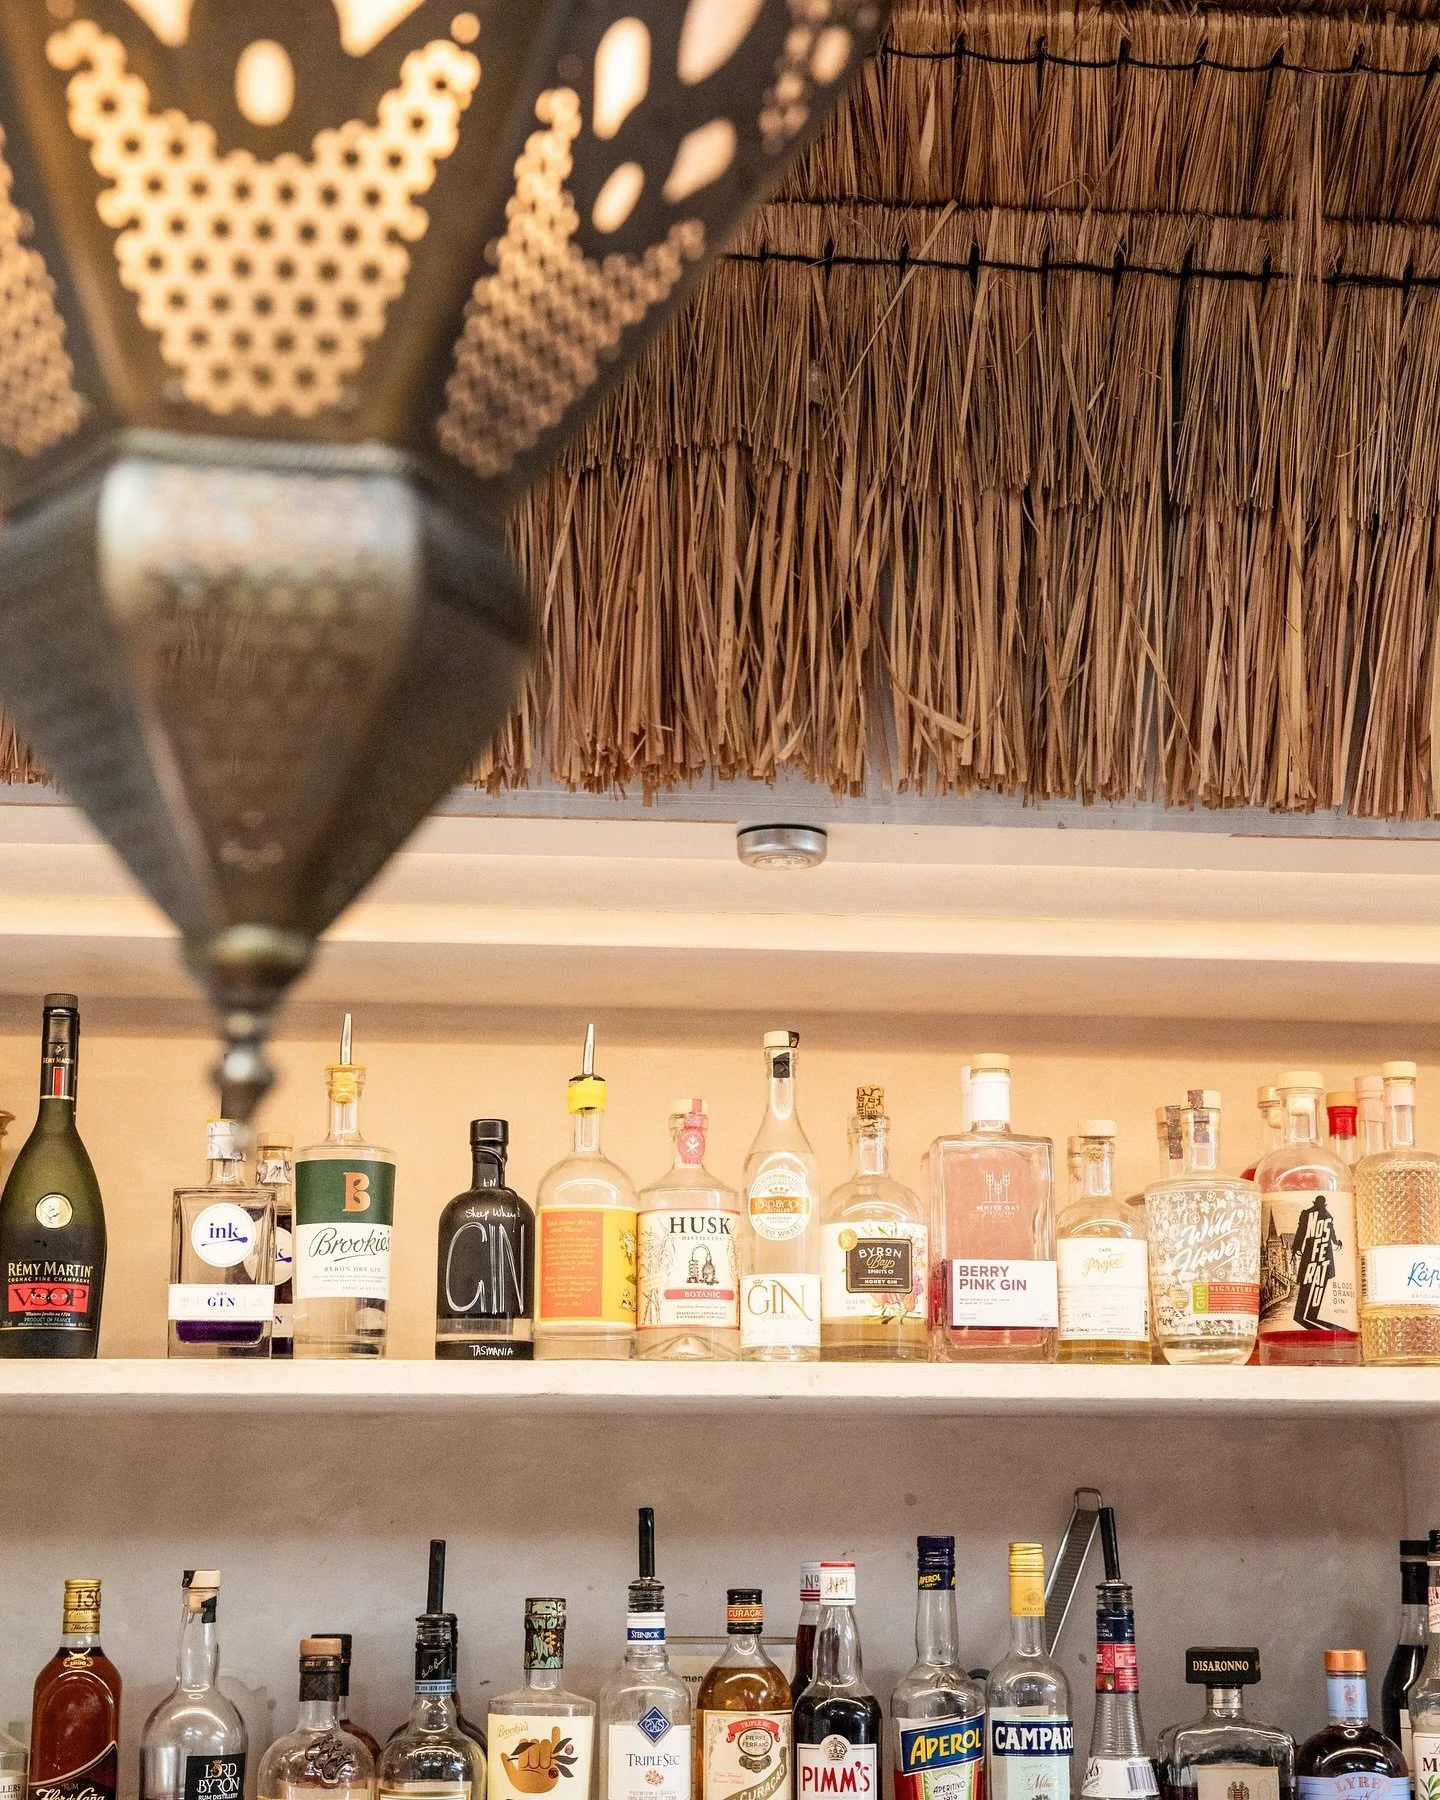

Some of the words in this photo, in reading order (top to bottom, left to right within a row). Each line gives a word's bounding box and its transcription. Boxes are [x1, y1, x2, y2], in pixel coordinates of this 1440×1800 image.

[341, 1171, 372, 1212] B
[208, 1221, 240, 1239] ink
[668, 1216, 731, 1235] HUSK
[858, 1246, 902, 1259] BYRON
[445, 1221, 525, 1315] GIN
[866, 1255, 896, 1269] Bay
[8, 1261, 41, 1277] RÉMY
[44, 1261, 91, 1278] MARTIN
[959, 1265, 1010, 1277] BERRY
[53, 1276, 90, 1284] CHAMPAGNE
[959, 1278, 996, 1291] PINK
[999, 1279, 1028, 1291] GIN
[683, 1290, 721, 1299] BOTANIC
[747, 1279, 814, 1322] GIN
[1195, 1286, 1206, 1310] GIN
[1333, 1297, 1346, 1305] GIN
[207, 1297, 236, 1307] GIN
[469, 1344, 514, 1357] TASMANIA
[631, 1629, 660, 1639] STEINBOK
[1192, 1660, 1250, 1672] DISARONNO
[995, 1726, 1074, 1750] CAMPARI
[910, 1727, 982, 1766] APEROL
[204, 1762, 237, 1779] LORD
[801, 1760, 871, 1793] PIMM'S
[196, 1777, 241, 1795] BYRON
[933, 1780, 966, 1794] APERITIVO
[212, 1792, 239, 1800] DISTILLERY
